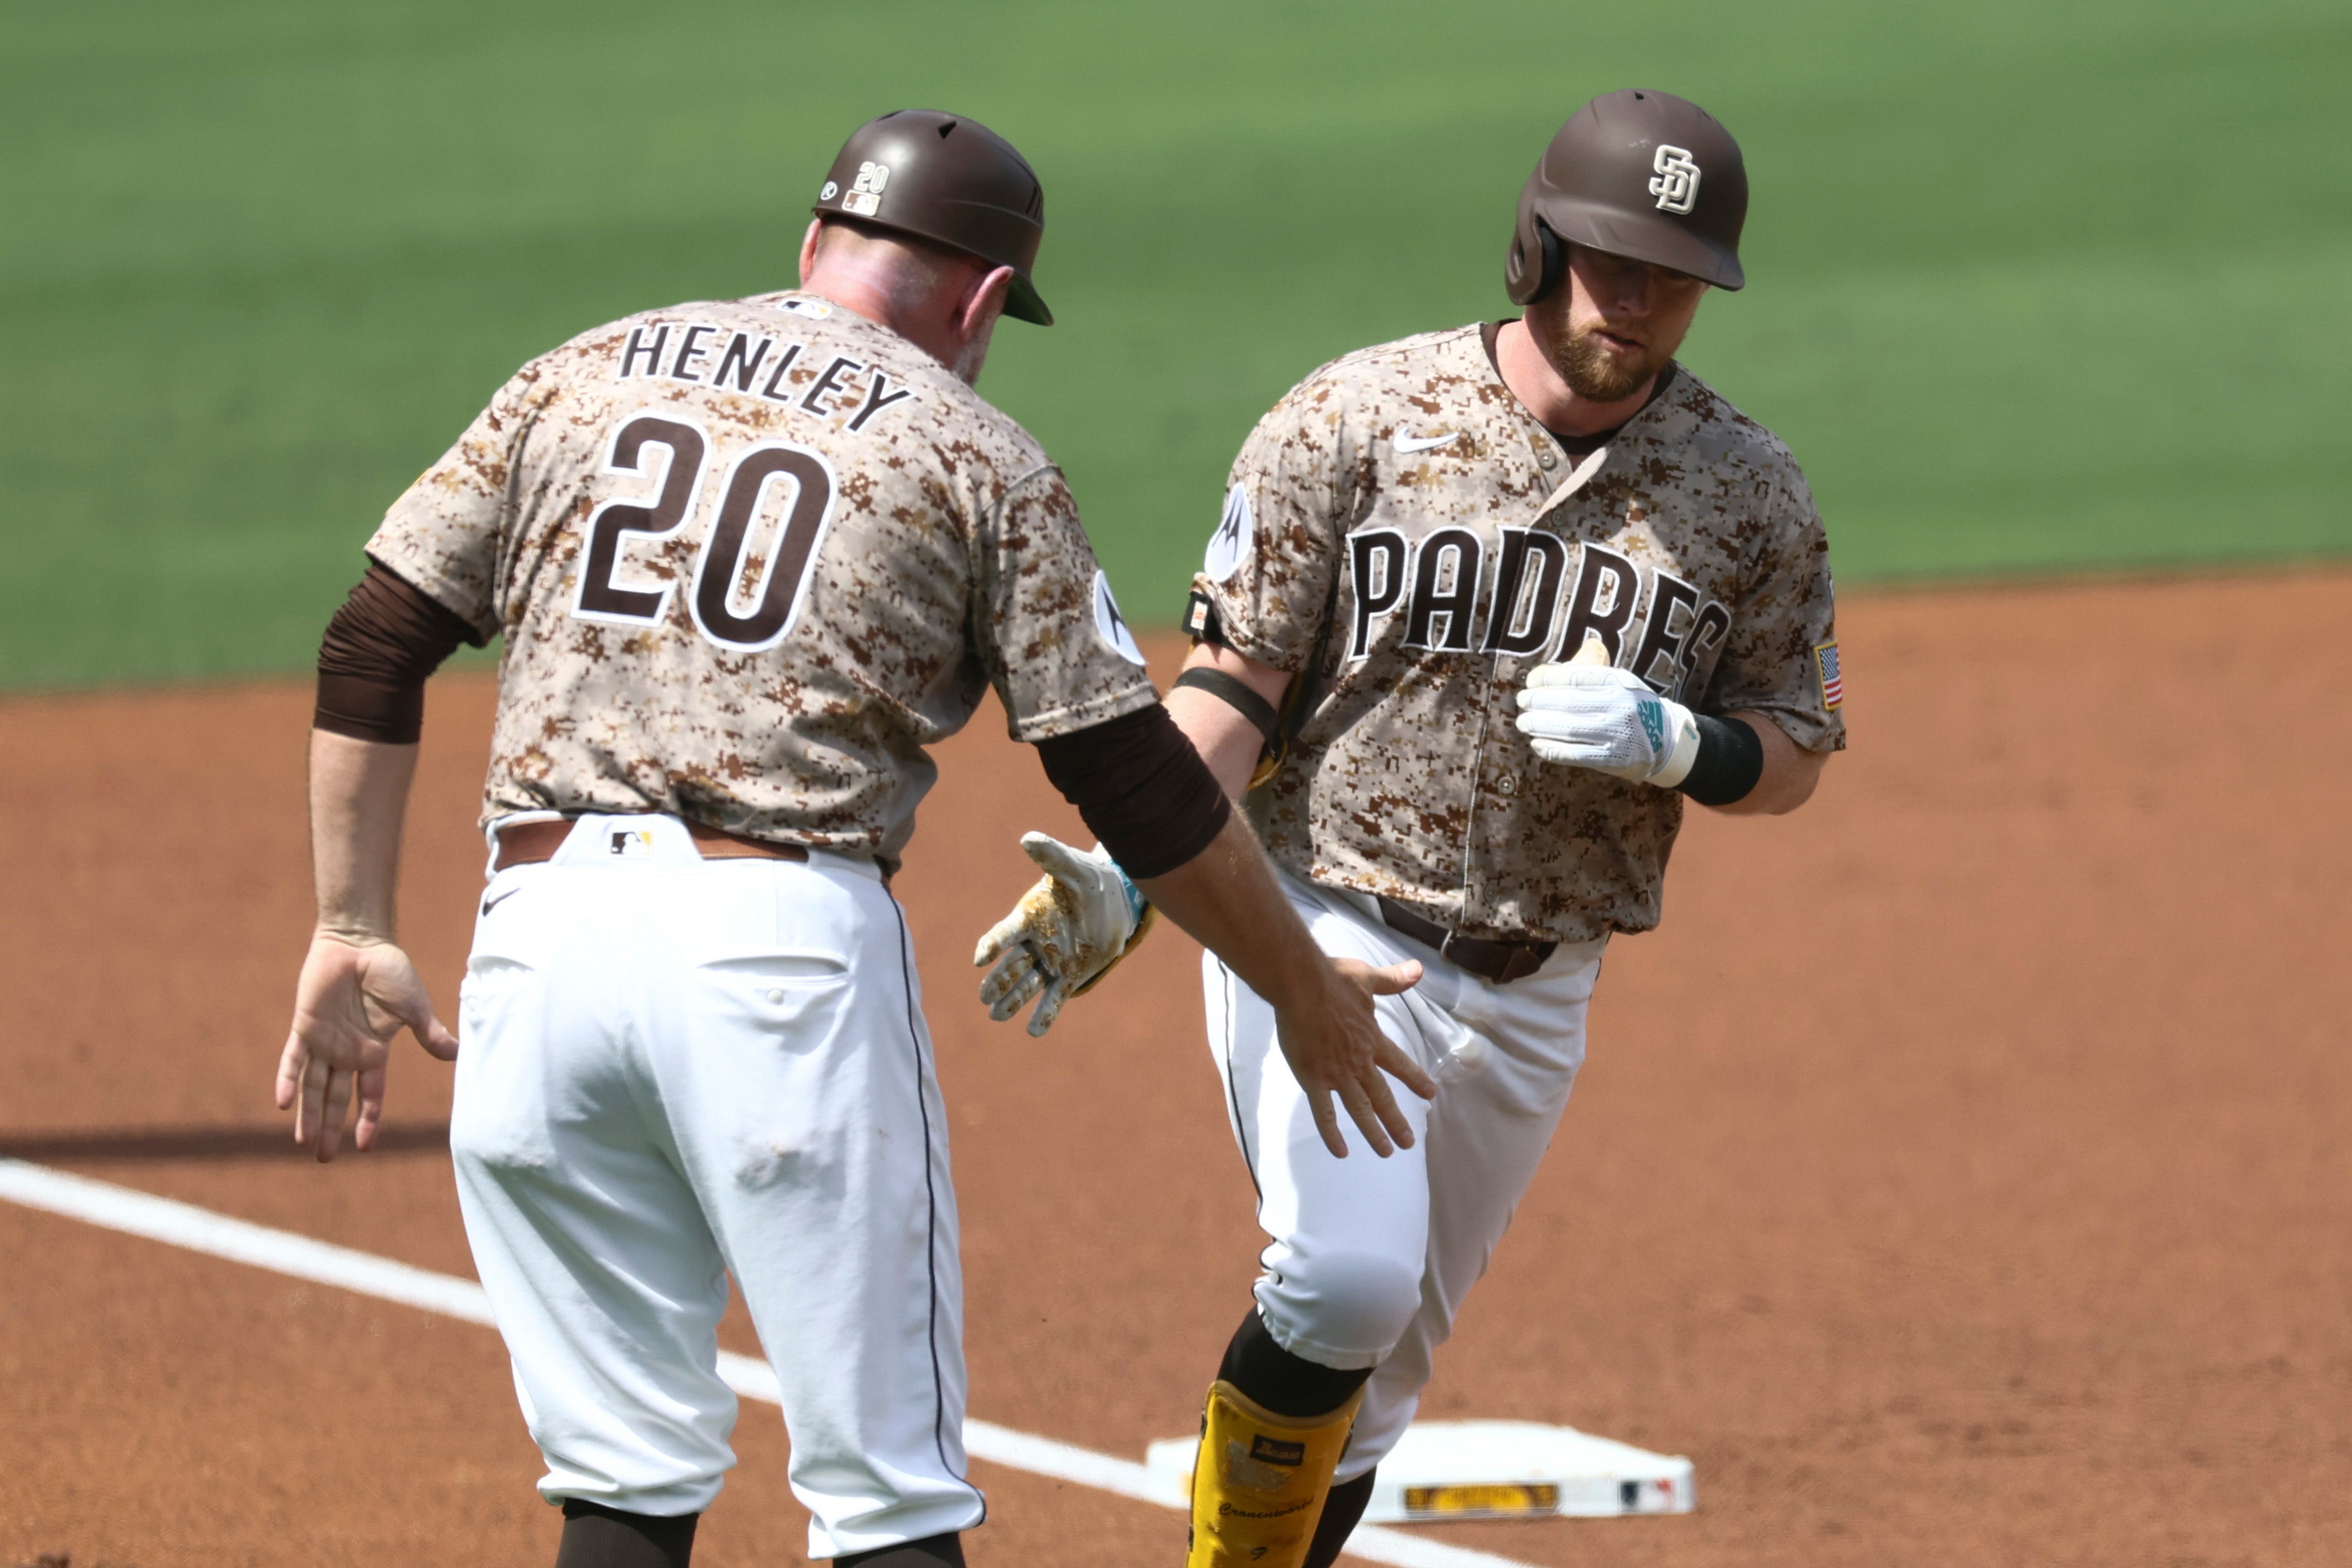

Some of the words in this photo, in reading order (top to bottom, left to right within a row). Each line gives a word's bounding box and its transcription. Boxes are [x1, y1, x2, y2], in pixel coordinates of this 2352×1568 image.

[854, 161, 889, 194] 20
[617, 322, 916, 436] HENLEY
[571, 409, 839, 653] 20
